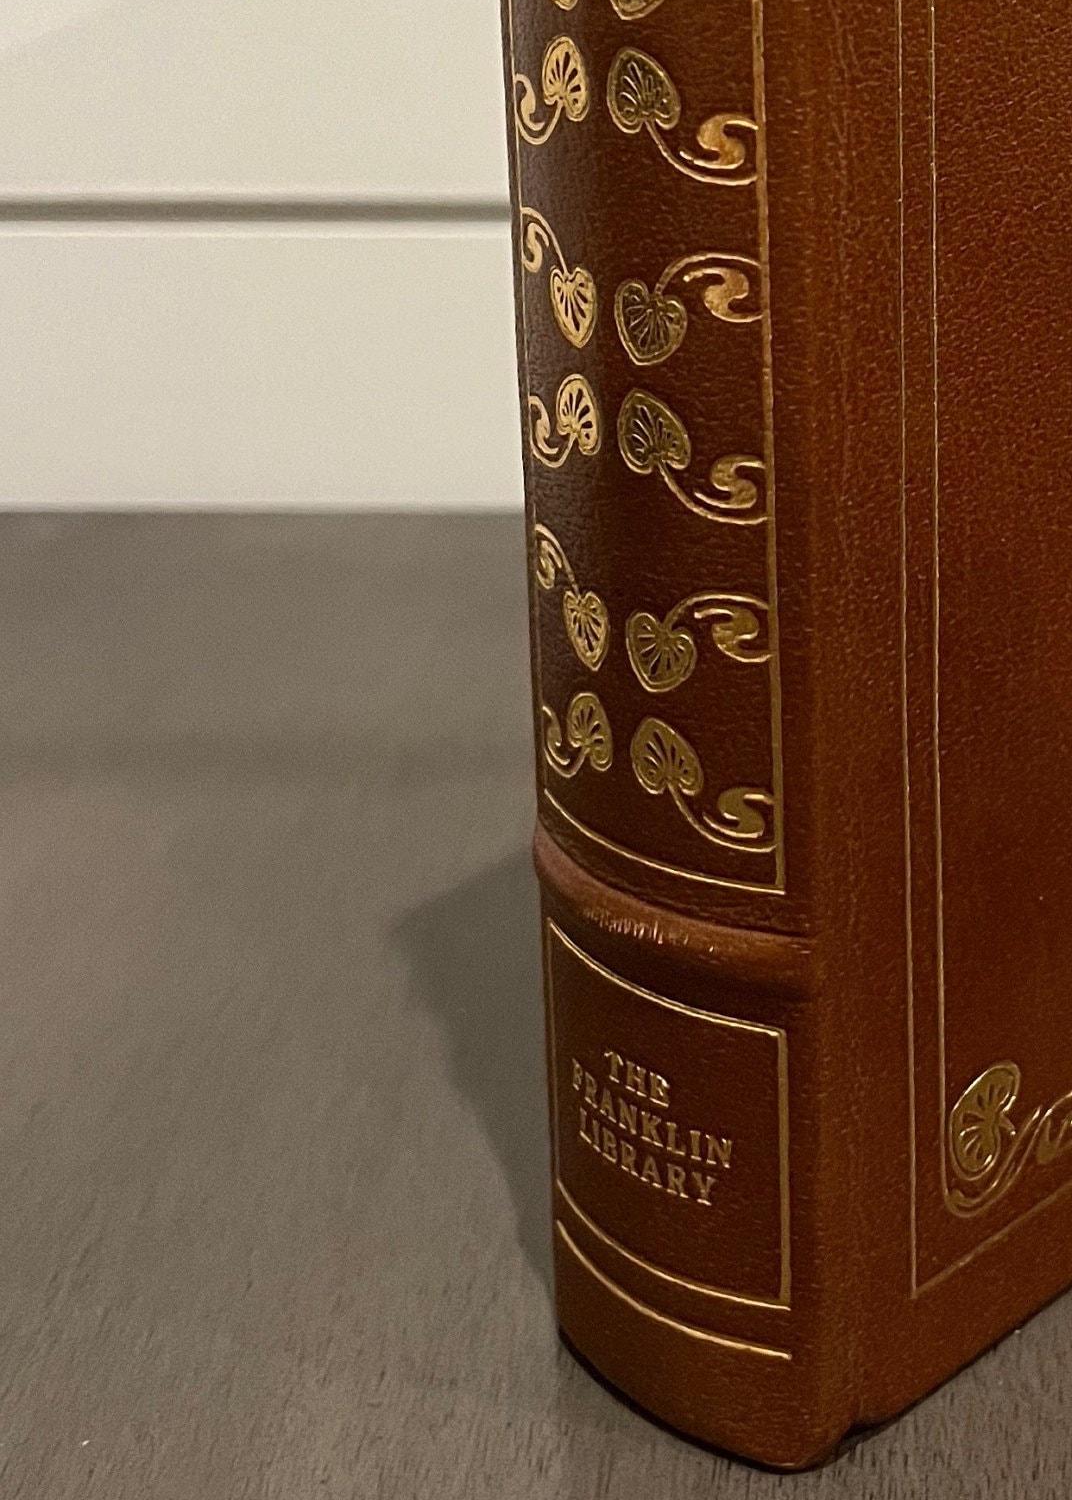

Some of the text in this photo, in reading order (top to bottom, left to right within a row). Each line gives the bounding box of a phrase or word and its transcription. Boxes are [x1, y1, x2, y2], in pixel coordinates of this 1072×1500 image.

[571, 1057, 733, 1169] FRANKLIN
[603, 1051, 670, 1108] THE
[579, 1106, 718, 1206] LIBRARY
